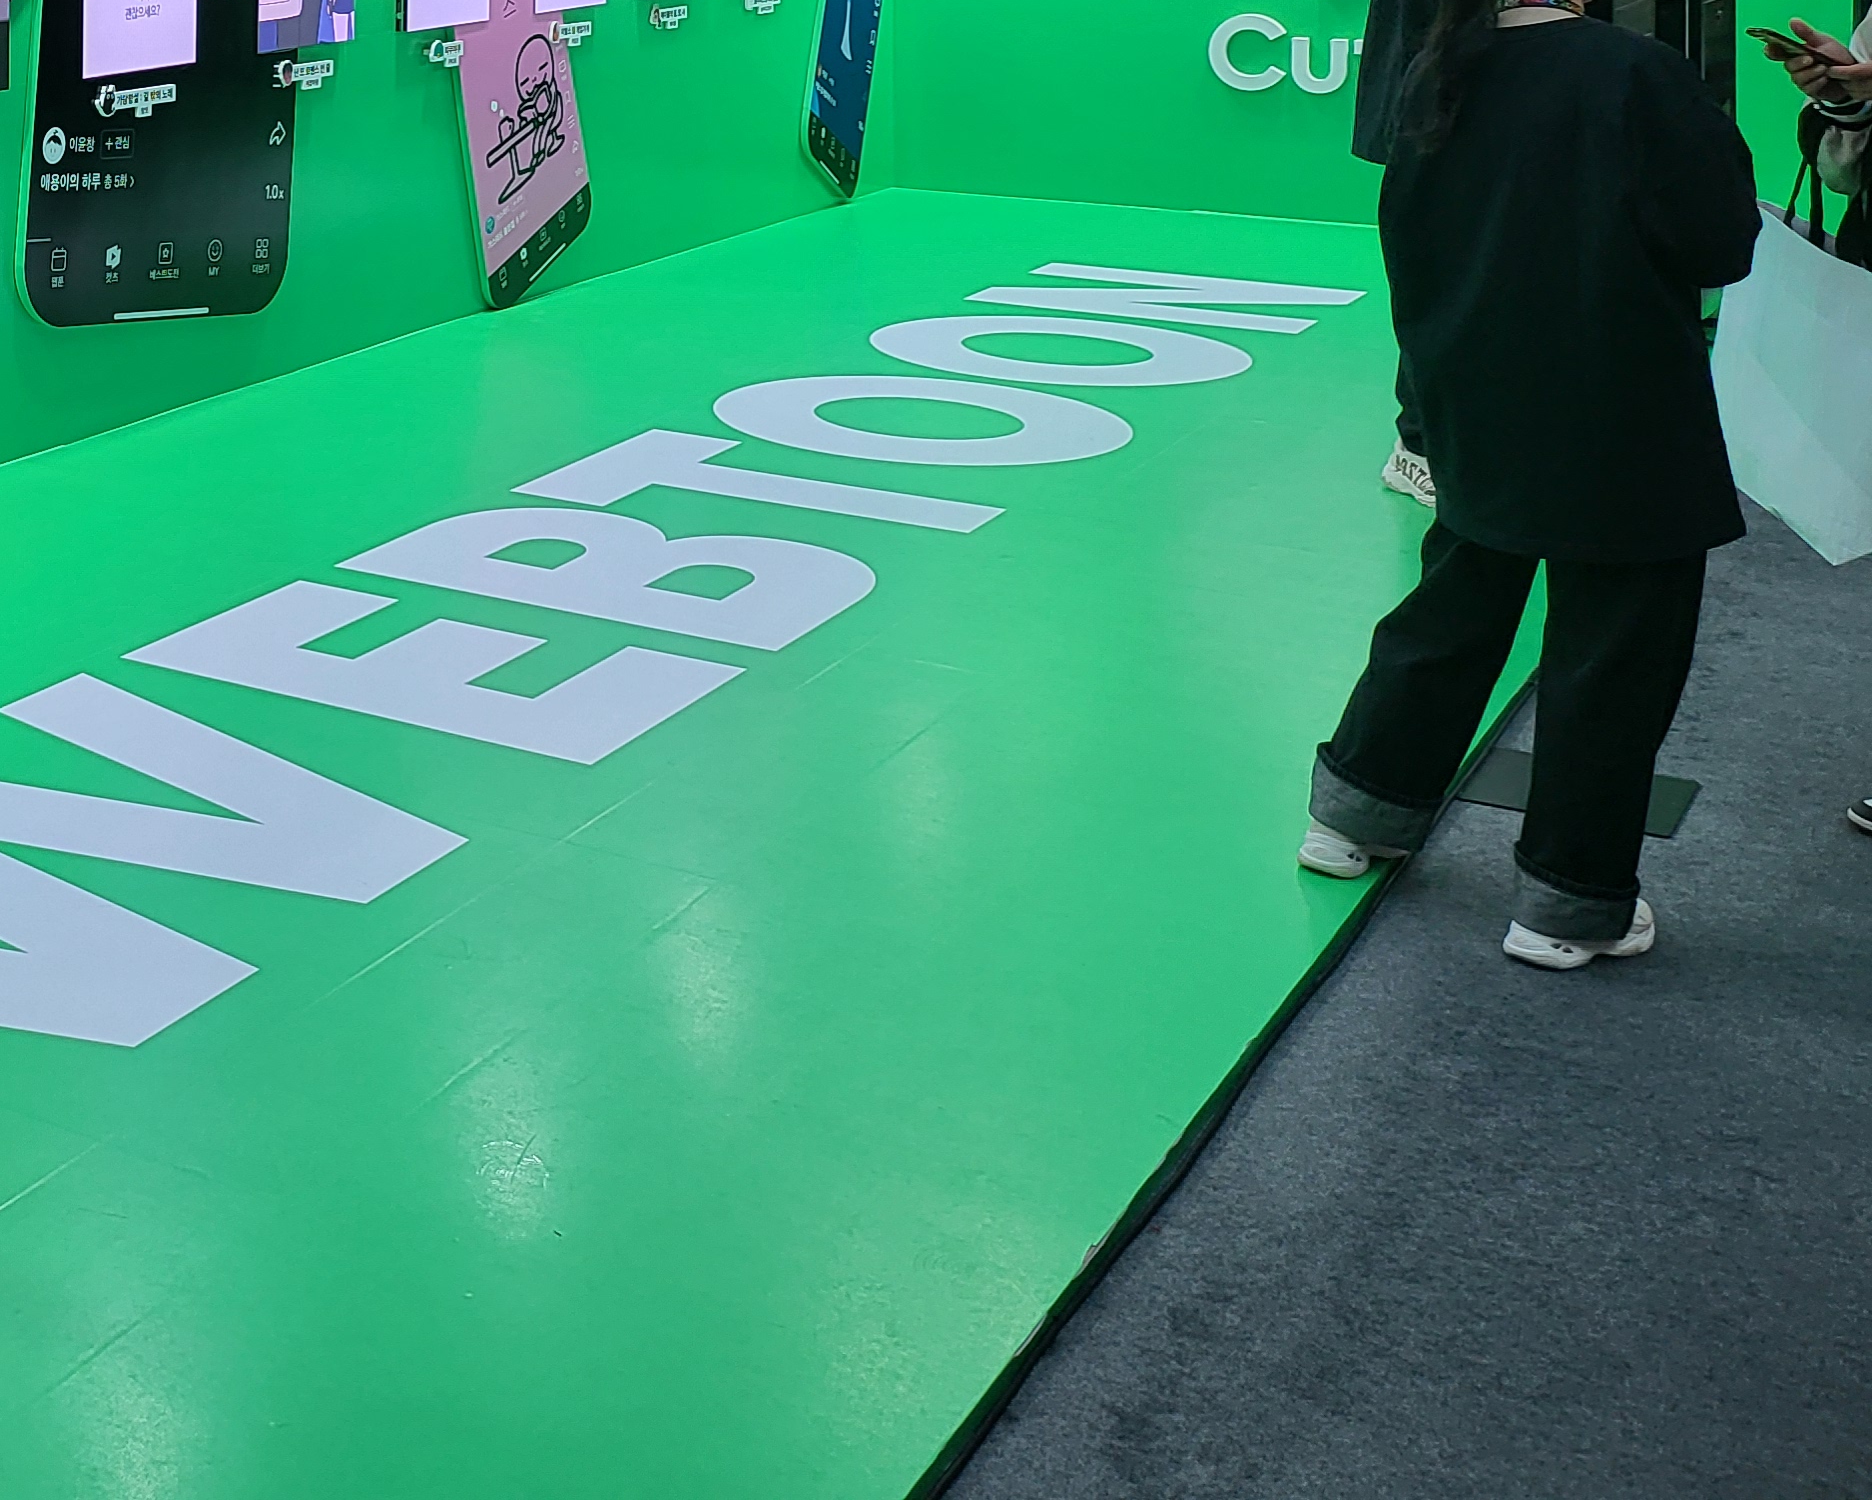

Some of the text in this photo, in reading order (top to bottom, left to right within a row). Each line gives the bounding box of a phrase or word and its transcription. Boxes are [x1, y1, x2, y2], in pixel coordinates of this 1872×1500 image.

[1207, 12, 1362, 93] Cu
[69, 136, 95, 153] 이윤창
[114, 135, 131, 150] 관심
[40, 172, 128, 192] 애용이의 하루 총 5화
[265, 185, 285, 200] 1.0x
[208, 266, 220, 277] MY
[252, 264, 270, 275] 더보기
